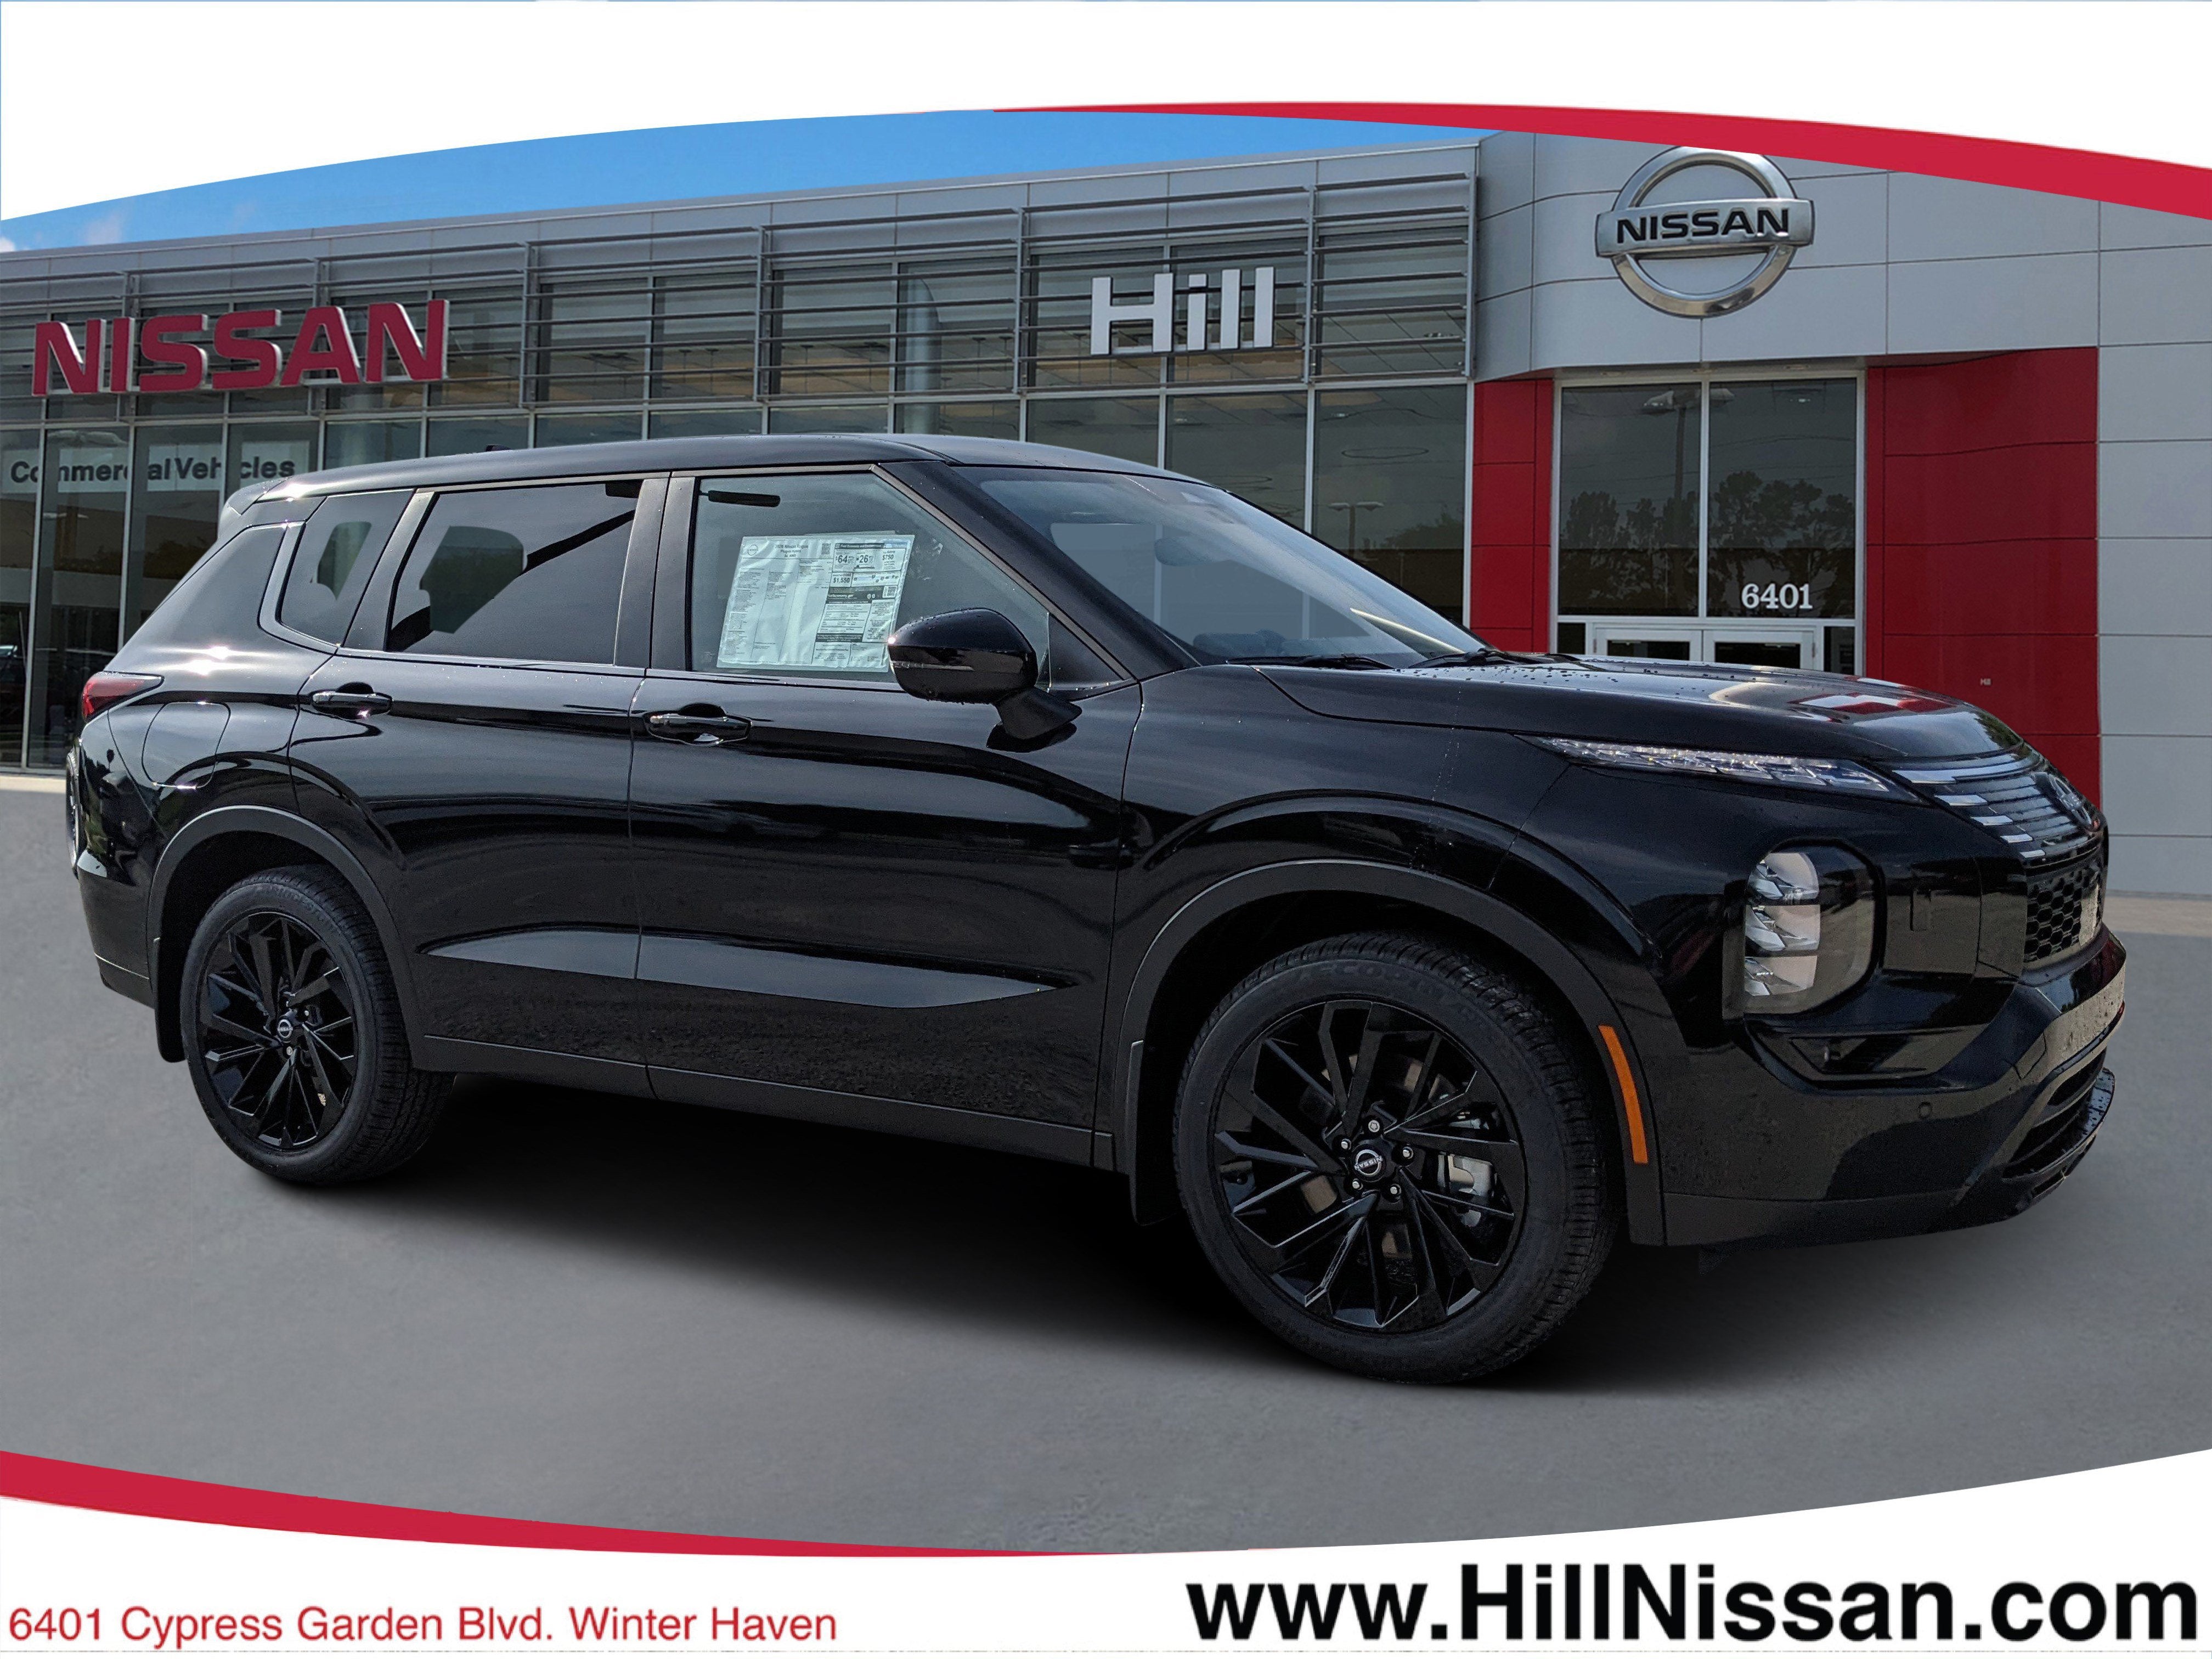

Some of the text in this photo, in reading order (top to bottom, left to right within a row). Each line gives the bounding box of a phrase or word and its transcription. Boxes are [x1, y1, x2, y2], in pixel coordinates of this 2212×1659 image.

[1617, 208, 1789, 244] NISSAN
[1090, 266, 1274, 356] Hill
[32, 300, 448, 396] NISSAN
[10, 456, 296, 483] Commeral Vehcles
[1741, 583, 1813, 610] 6401
[1354, 1155, 1383, 1171] NISSAN
